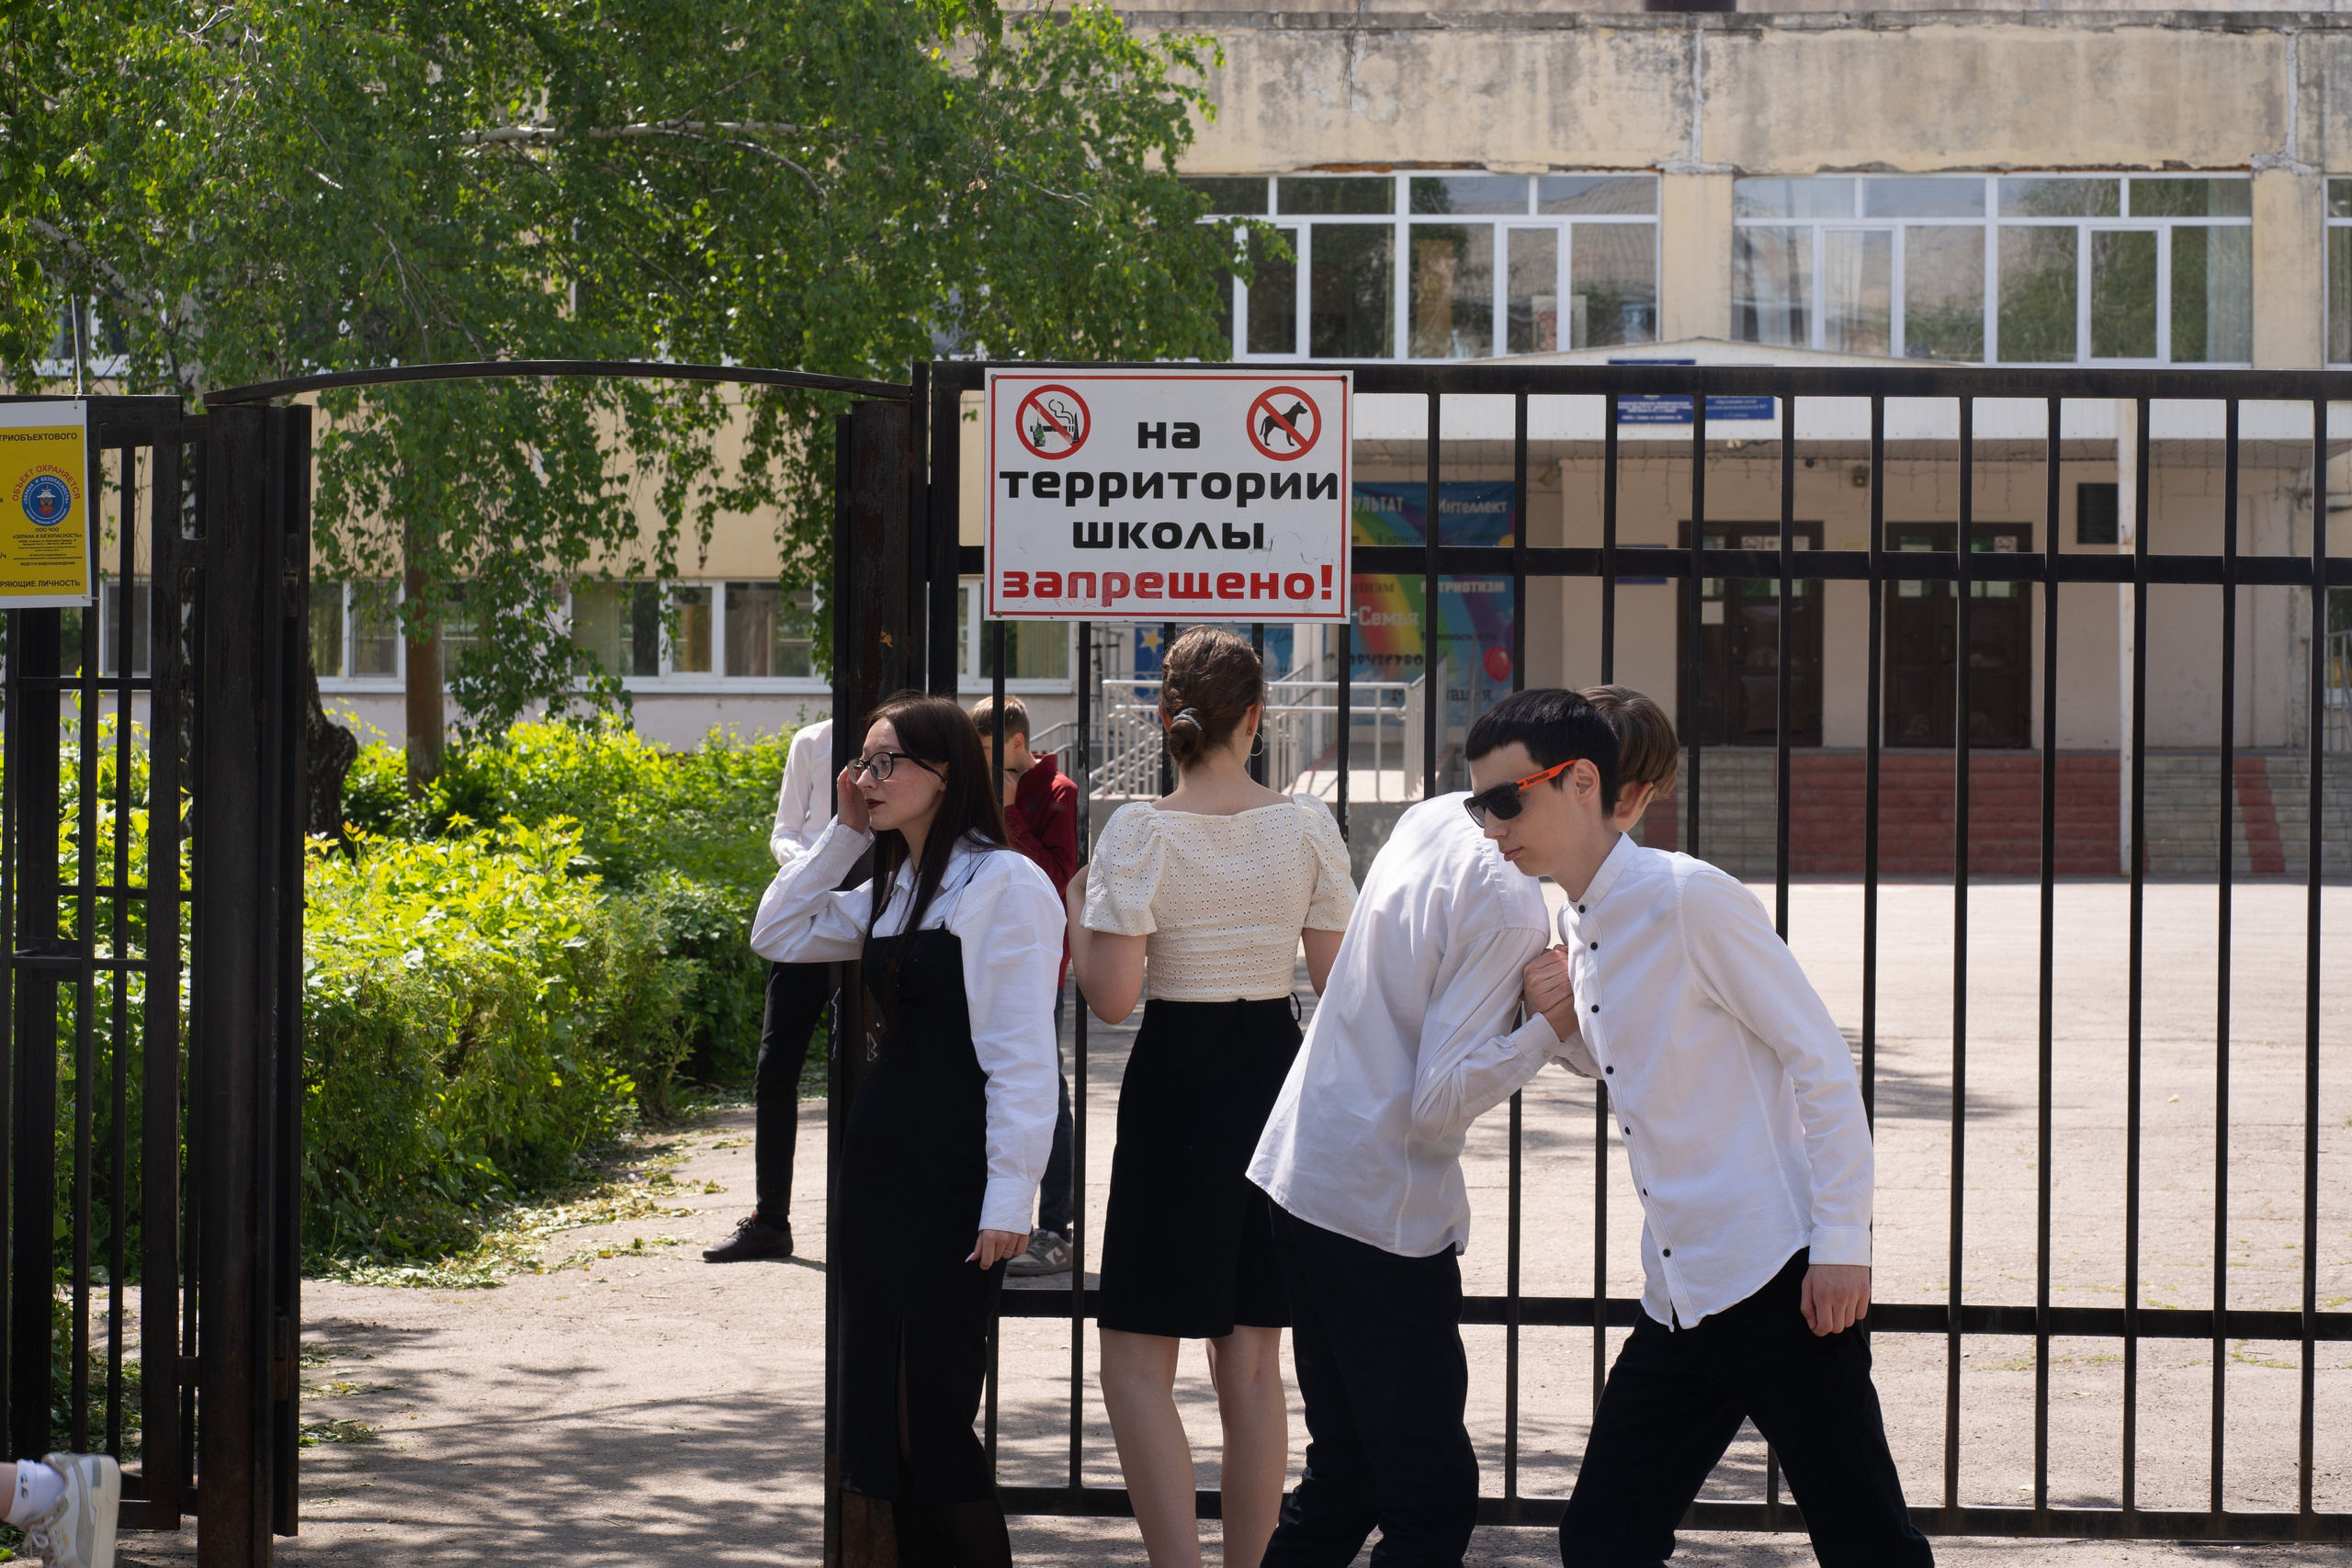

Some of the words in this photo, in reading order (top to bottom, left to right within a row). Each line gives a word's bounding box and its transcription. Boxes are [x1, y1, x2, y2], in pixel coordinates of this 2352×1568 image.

[1136, 421, 1201, 449] на
[12, 468, 34, 502] ОБЪЕКТ
[36, 465, 81, 499] ОХРАНЯЕТСЯ
[999, 470, 1339, 508] территории
[1072, 521, 1264, 549] школы
[1002, 564, 1334, 607] запрещено!
[1420, 581, 1506, 592] ПТРИОТИЗМ
[1359, 605, 1420, 626] Семья
